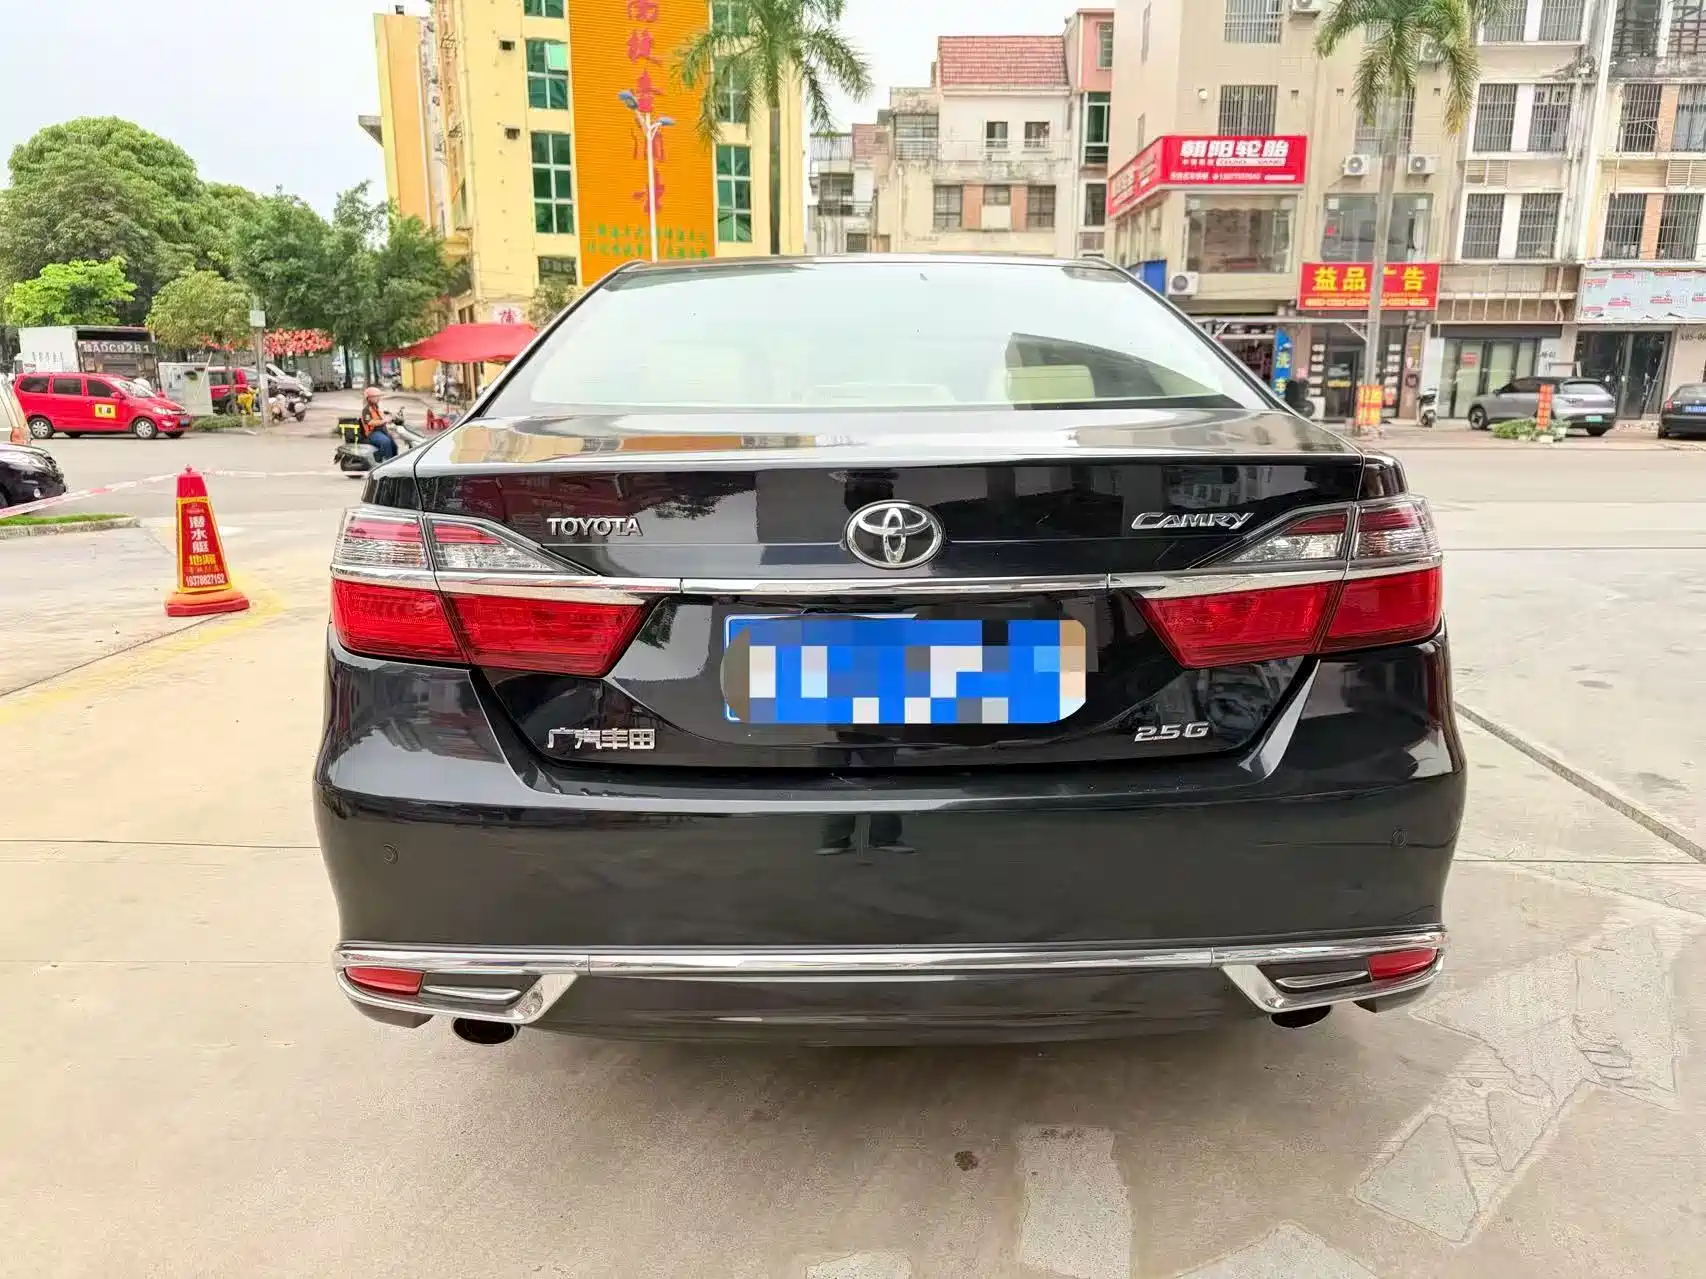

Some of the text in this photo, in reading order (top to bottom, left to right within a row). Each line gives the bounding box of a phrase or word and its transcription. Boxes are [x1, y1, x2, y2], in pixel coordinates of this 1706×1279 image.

[1180, 140, 1289, 158] 朝阳轮胎
[547, 517, 643, 537] TOYOTA
[1131, 511, 1255, 530] CAMRY
[547, 727, 656, 750] 广汽丰田
